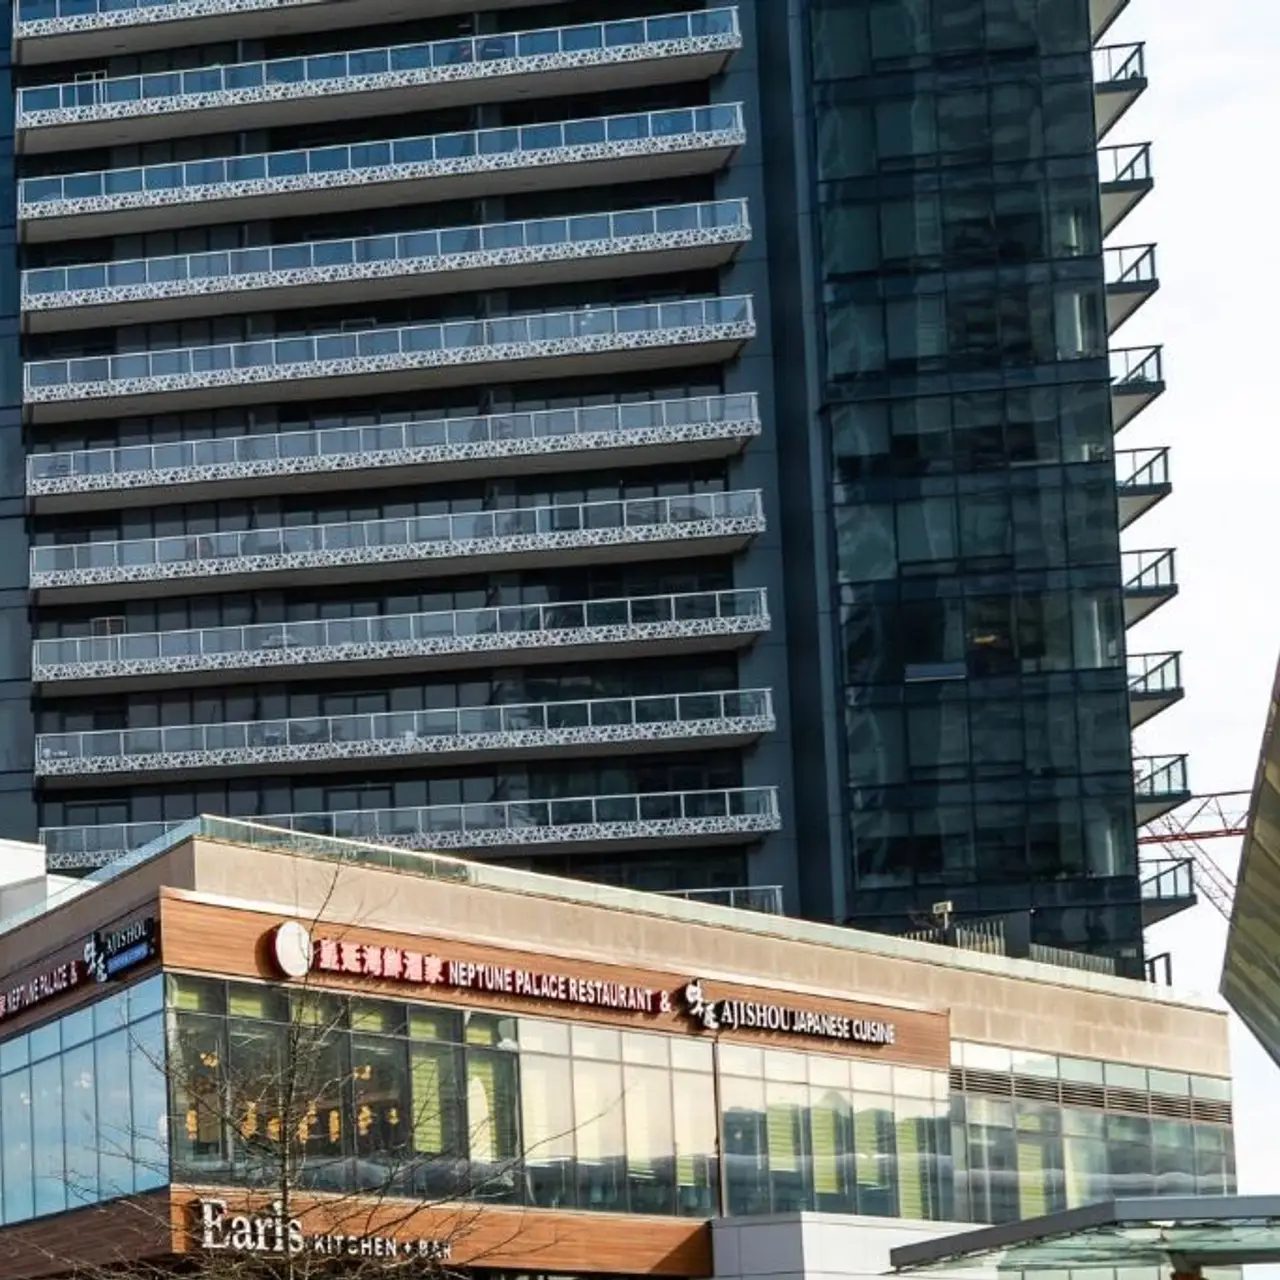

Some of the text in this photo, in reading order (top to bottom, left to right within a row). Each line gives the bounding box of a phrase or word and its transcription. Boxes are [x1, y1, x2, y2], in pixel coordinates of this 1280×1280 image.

[448, 960, 672, 1012] NEPTUNE PALACE RESTAURANT &
[721, 1000, 896, 1044] AJISHOU JAPANESE CUISINE
[200, 1198, 304, 1253] Earls
[314, 1233, 397, 1257] KITCHEN
[418, 1239, 452, 1259] BAR
